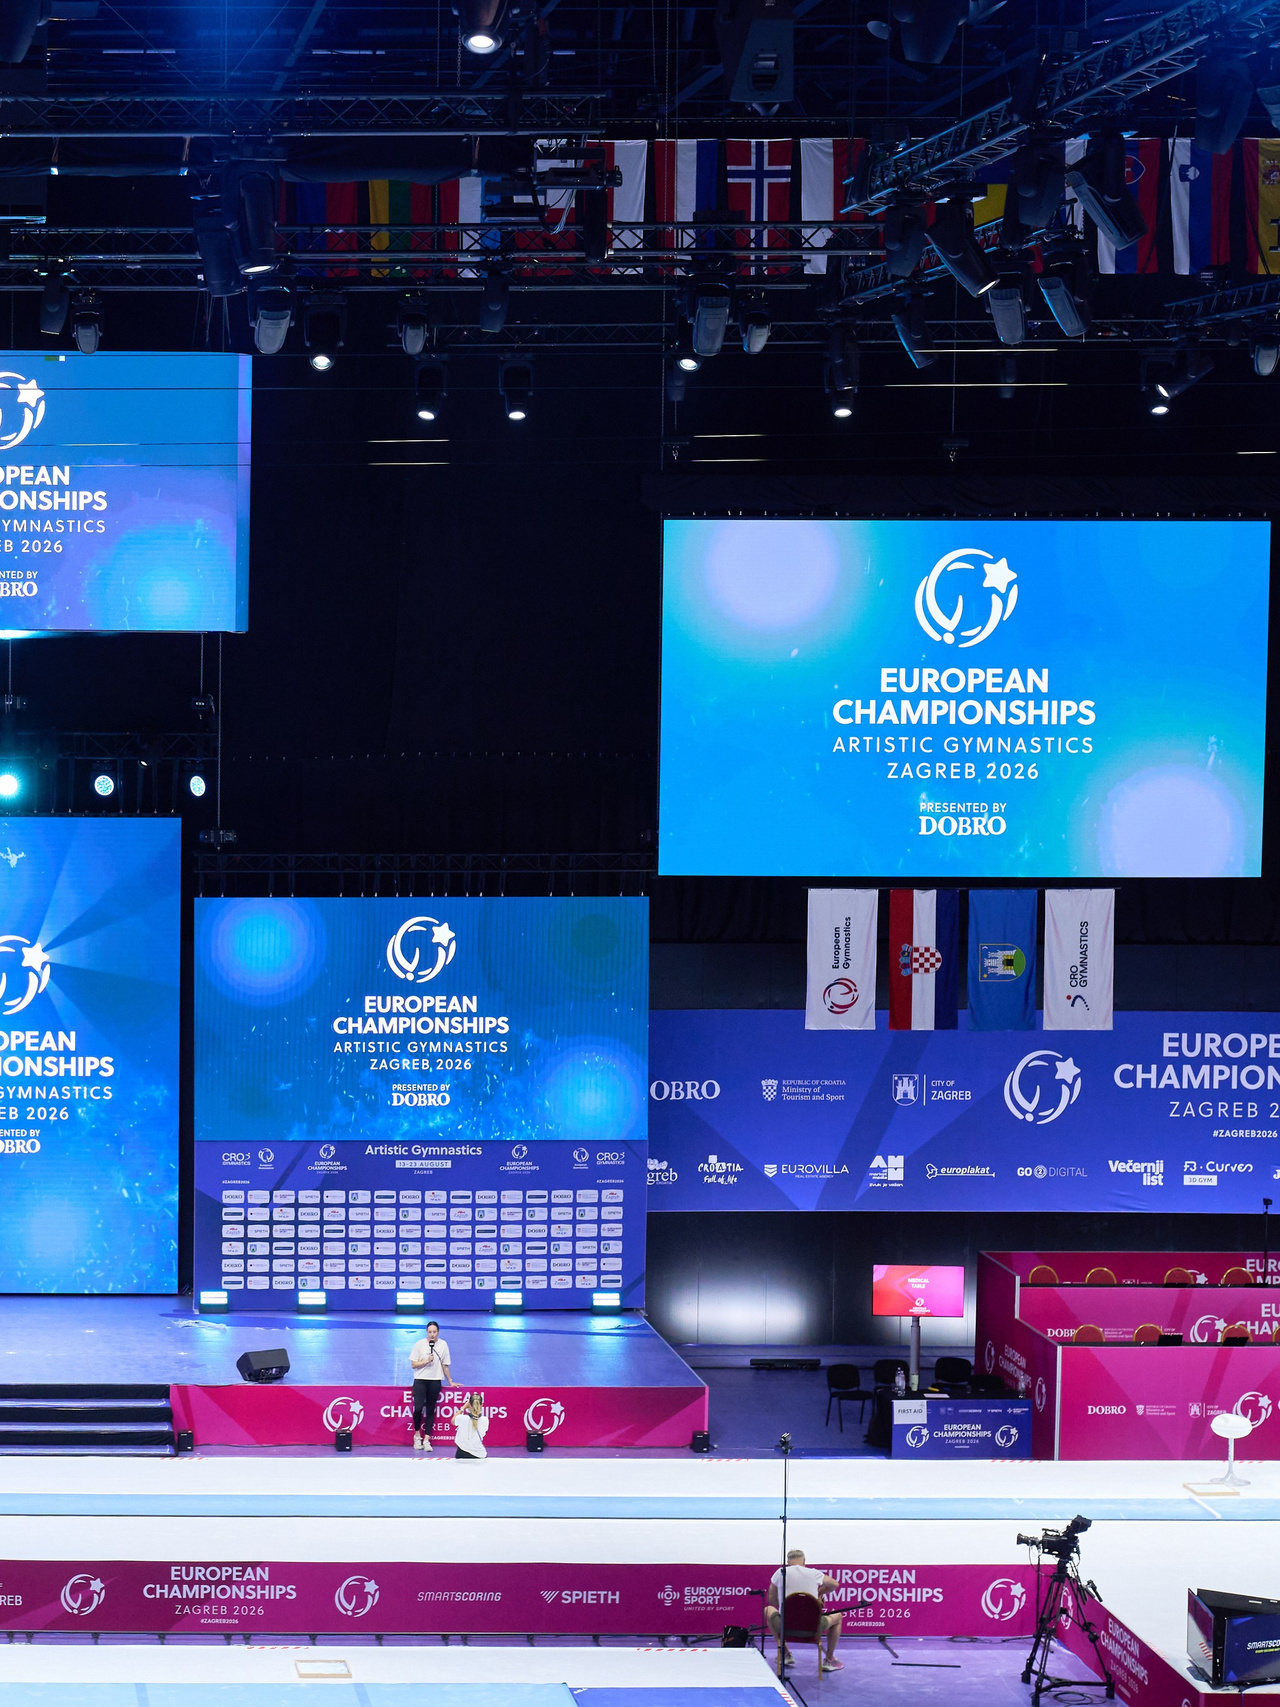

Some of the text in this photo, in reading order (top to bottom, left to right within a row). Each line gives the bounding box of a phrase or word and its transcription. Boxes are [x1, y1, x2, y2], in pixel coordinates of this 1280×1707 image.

[21, 539, 63, 553] 2026
[26, 571, 38, 579] BY
[880, 668, 1049, 693] EUROPEAN
[833, 699, 1096, 725] CHAMPIONSHIPS
[833, 737, 1093, 753] ARTISTIC GYMNASTICS
[887, 762, 1038, 779] ZAGREB 2026
[920, 802, 1007, 813] PRESENTED BY
[918, 816, 1006, 836] DOBRO
[832, 927, 841, 969] European
[842, 917, 852, 969] Gymnastics
[1079, 921, 1089, 988] GYMNASTICS
[1069, 965, 1078, 988] CRO
[365, 995, 477, 1013] EUROPEAN
[333, 1016, 509, 1034] CHAMPIONSHIPS
[333, 1041, 508, 1053] ARTISTIC GYMNASTICS
[370, 1058, 472, 1070] ZAGREB 2026
[782, 1086, 812, 1094] Ministry
[931, 1090, 971, 1100] ZAGREB
[391, 1092, 450, 1107] DOBRO
[826, 1093, 844, 1102] Sport
[26, 1106, 69, 1121] 2026
[1169, 1101, 1258, 1118] ZAGREB
[29, 1129, 40, 1137] BY
[1213, 1129, 1278, 1138] #ZAGREB2026
[222, 1153, 245, 1162] CRO
[365, 1144, 482, 1158] Artistic Gymnastics
[596, 1152, 619, 1161] CRO
[698, 1162, 744, 1173] CROATIA
[782, 1164, 849, 1174] EUROVILLA
[940, 1165, 990, 1174] europlakat
[1108, 1160, 1164, 1173] Večernji
[1143, 1172, 1164, 1186] list
[1088, 1405, 1126, 1415] DOBRO
[171, 1566, 269, 1581] EUROPEAN
[143, 1584, 297, 1599] CHAMPIONSHIPS
[417, 1592, 502, 1601] SMARTSCORING
[561, 1590, 619, 1604] SPIETH
[684, 1587, 752, 1595] EUROVISION
[684, 1596, 720, 1604] SPORT
[175, 1605, 264, 1615] ZAGREB 2026
[880, 1608, 911, 1618] 2026
[1108, 1617, 1140, 1659] EUROPEAN
[1101, 1631, 1148, 1686] CHAMPIONSHIPS
